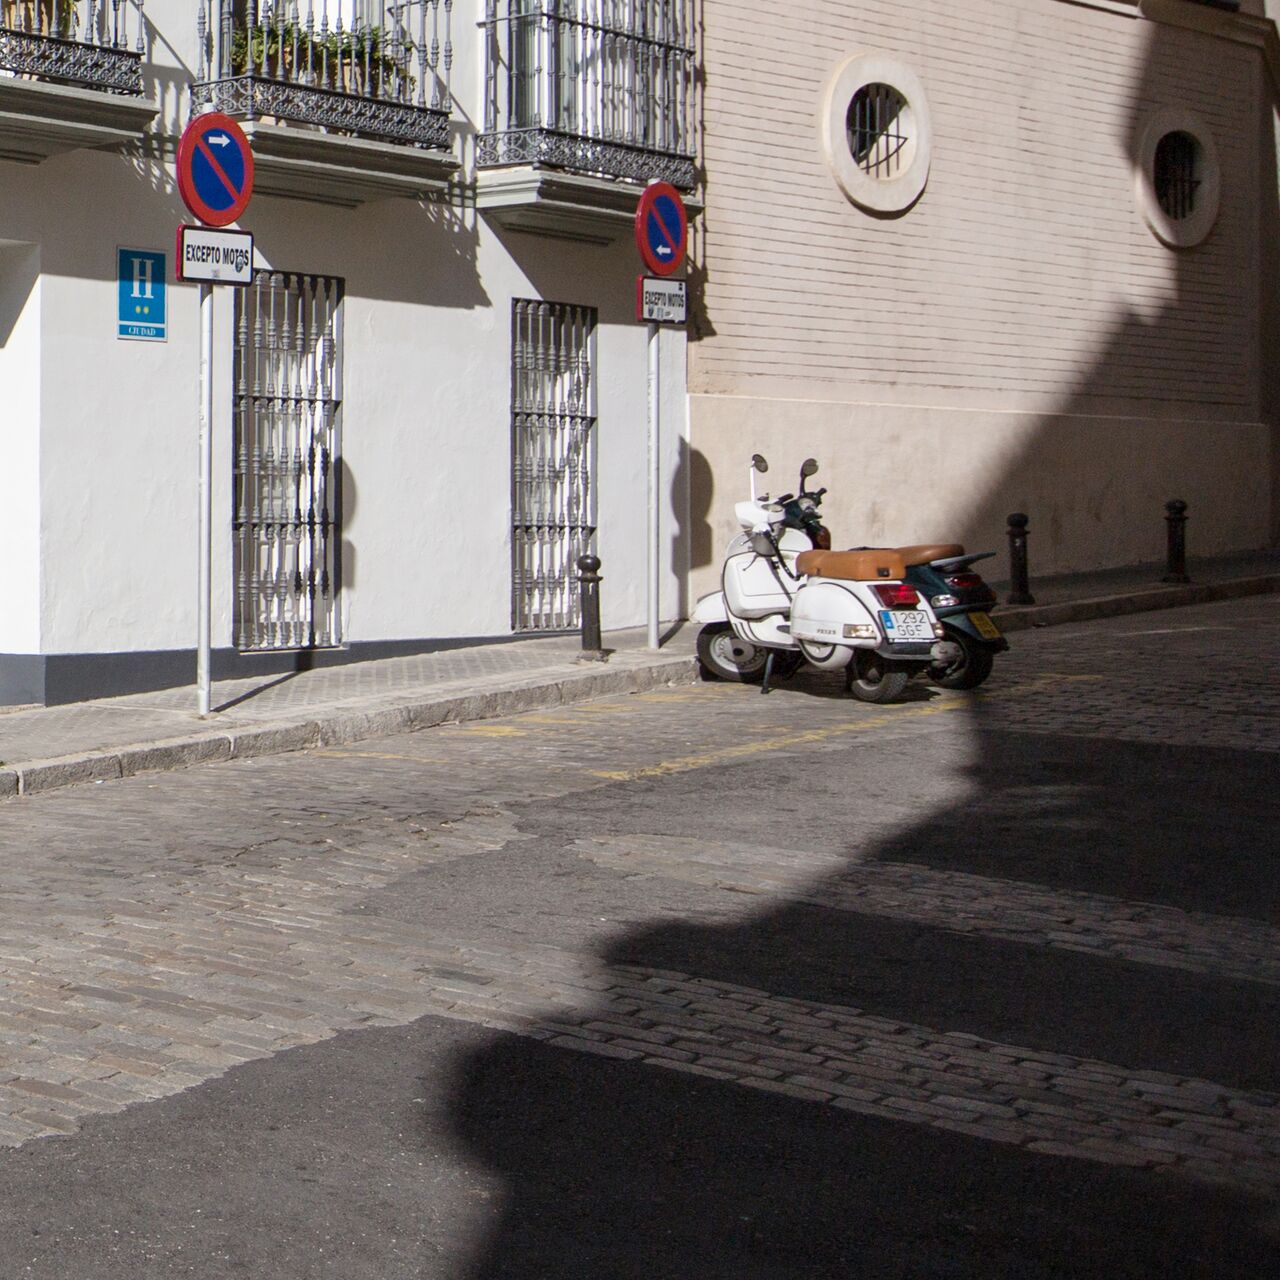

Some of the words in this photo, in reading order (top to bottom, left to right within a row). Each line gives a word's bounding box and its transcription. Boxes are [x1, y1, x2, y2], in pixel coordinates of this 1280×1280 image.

[186, 244, 221, 264] EXCEPTO
[130, 258, 155, 299] H
[129, 327, 155, 336] CIUDAD
[892, 612, 927, 624] 1292
